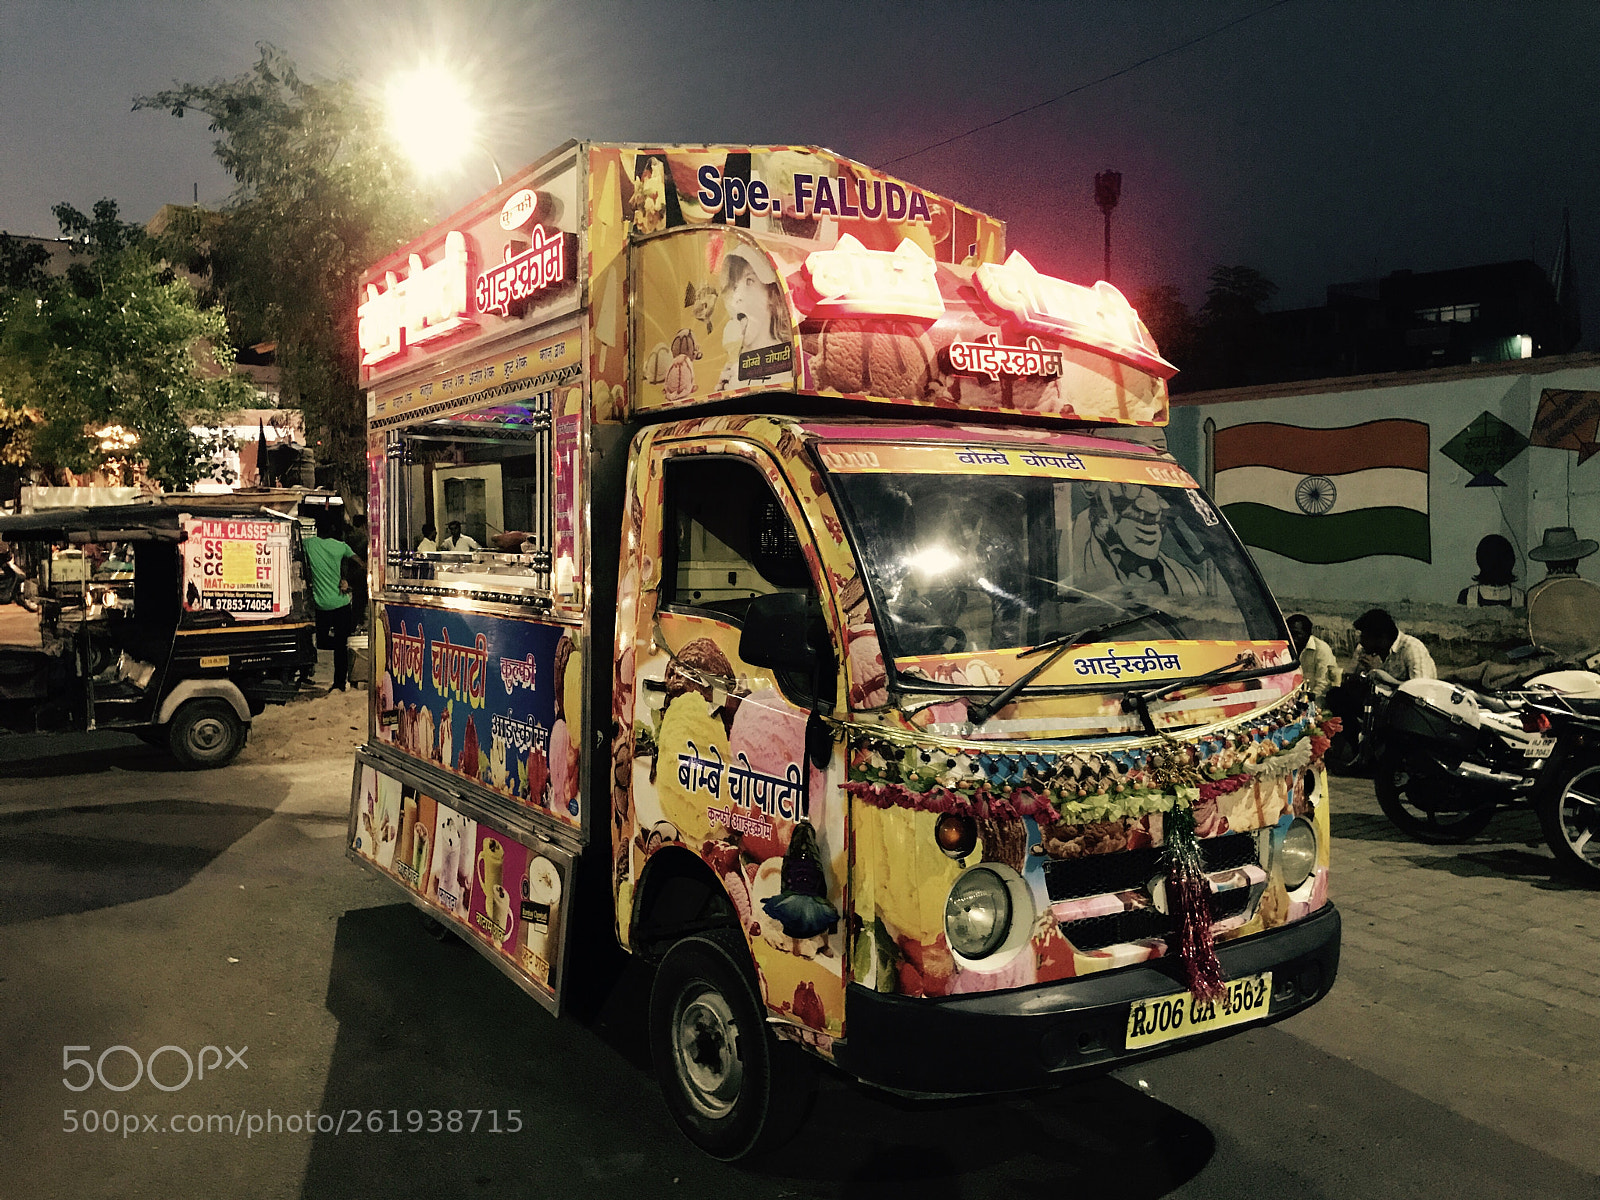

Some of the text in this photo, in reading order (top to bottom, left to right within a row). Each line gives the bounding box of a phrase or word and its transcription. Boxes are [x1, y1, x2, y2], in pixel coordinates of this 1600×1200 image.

[697, 164, 932, 225] Spe. FALUDA
[475, 223, 564, 317] आईस्क्रीम
[949, 332, 1064, 382] आईस्क्रीम
[954, 449, 1087, 471] बोम्बे चोपाटी
[202, 522, 273, 540] N.M. CLASSES
[204, 540, 223, 561] SS
[204, 562, 223, 576] CG
[203, 599, 272, 611] M. 97853-74054
[431, 626, 489, 709] चोपाटी
[499, 652, 536, 695] कुल्फी
[1073, 647, 1182, 679] आईस्क्रीम
[677, 740, 803, 824] बोम्बे चोपाटी
[707, 805, 773, 841] कुल्फी आईस्क्रीम
[1130, 998, 1185, 1038] RJ06
